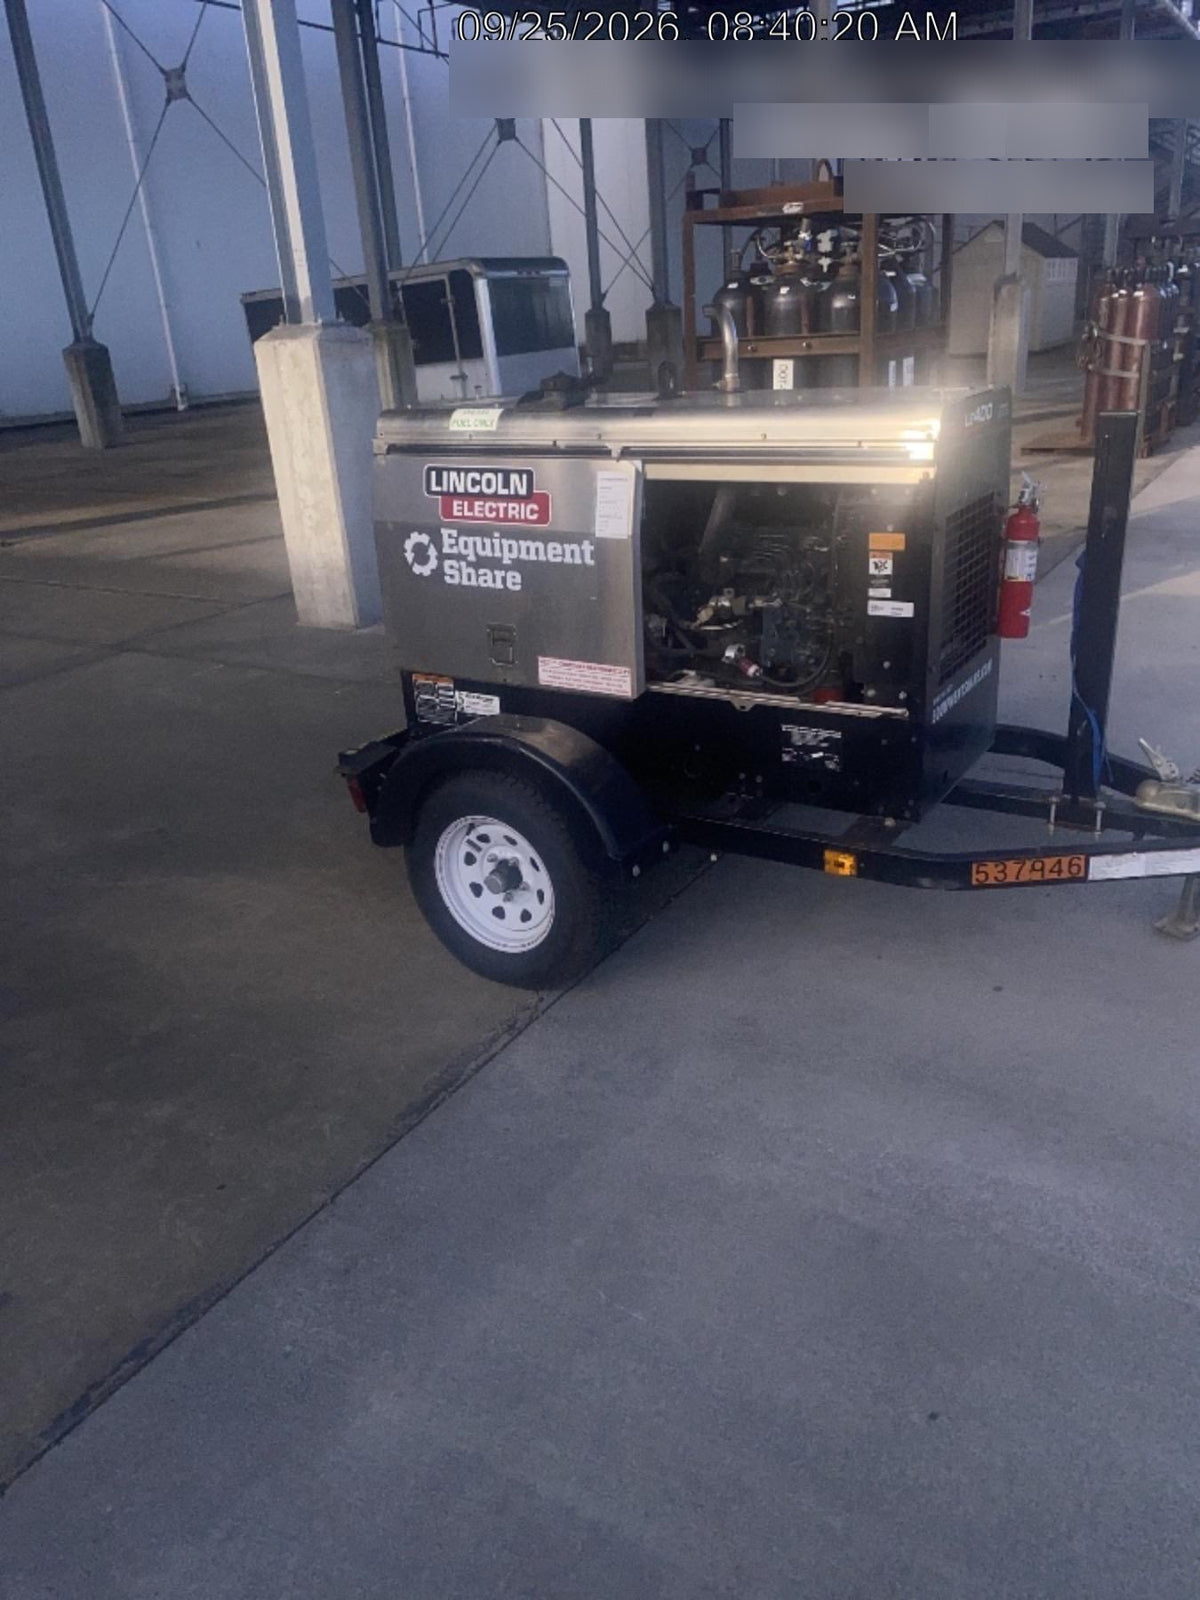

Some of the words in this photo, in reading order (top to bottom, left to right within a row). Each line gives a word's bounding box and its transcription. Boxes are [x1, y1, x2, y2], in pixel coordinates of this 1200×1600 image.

[430, 470, 527, 496] LINCOLN
[452, 500, 539, 520] ELECTRIC
[440, 528, 595, 566] Equipment
[443, 559, 522, 591] Share
[975, 856, 1082, 883] 537946
